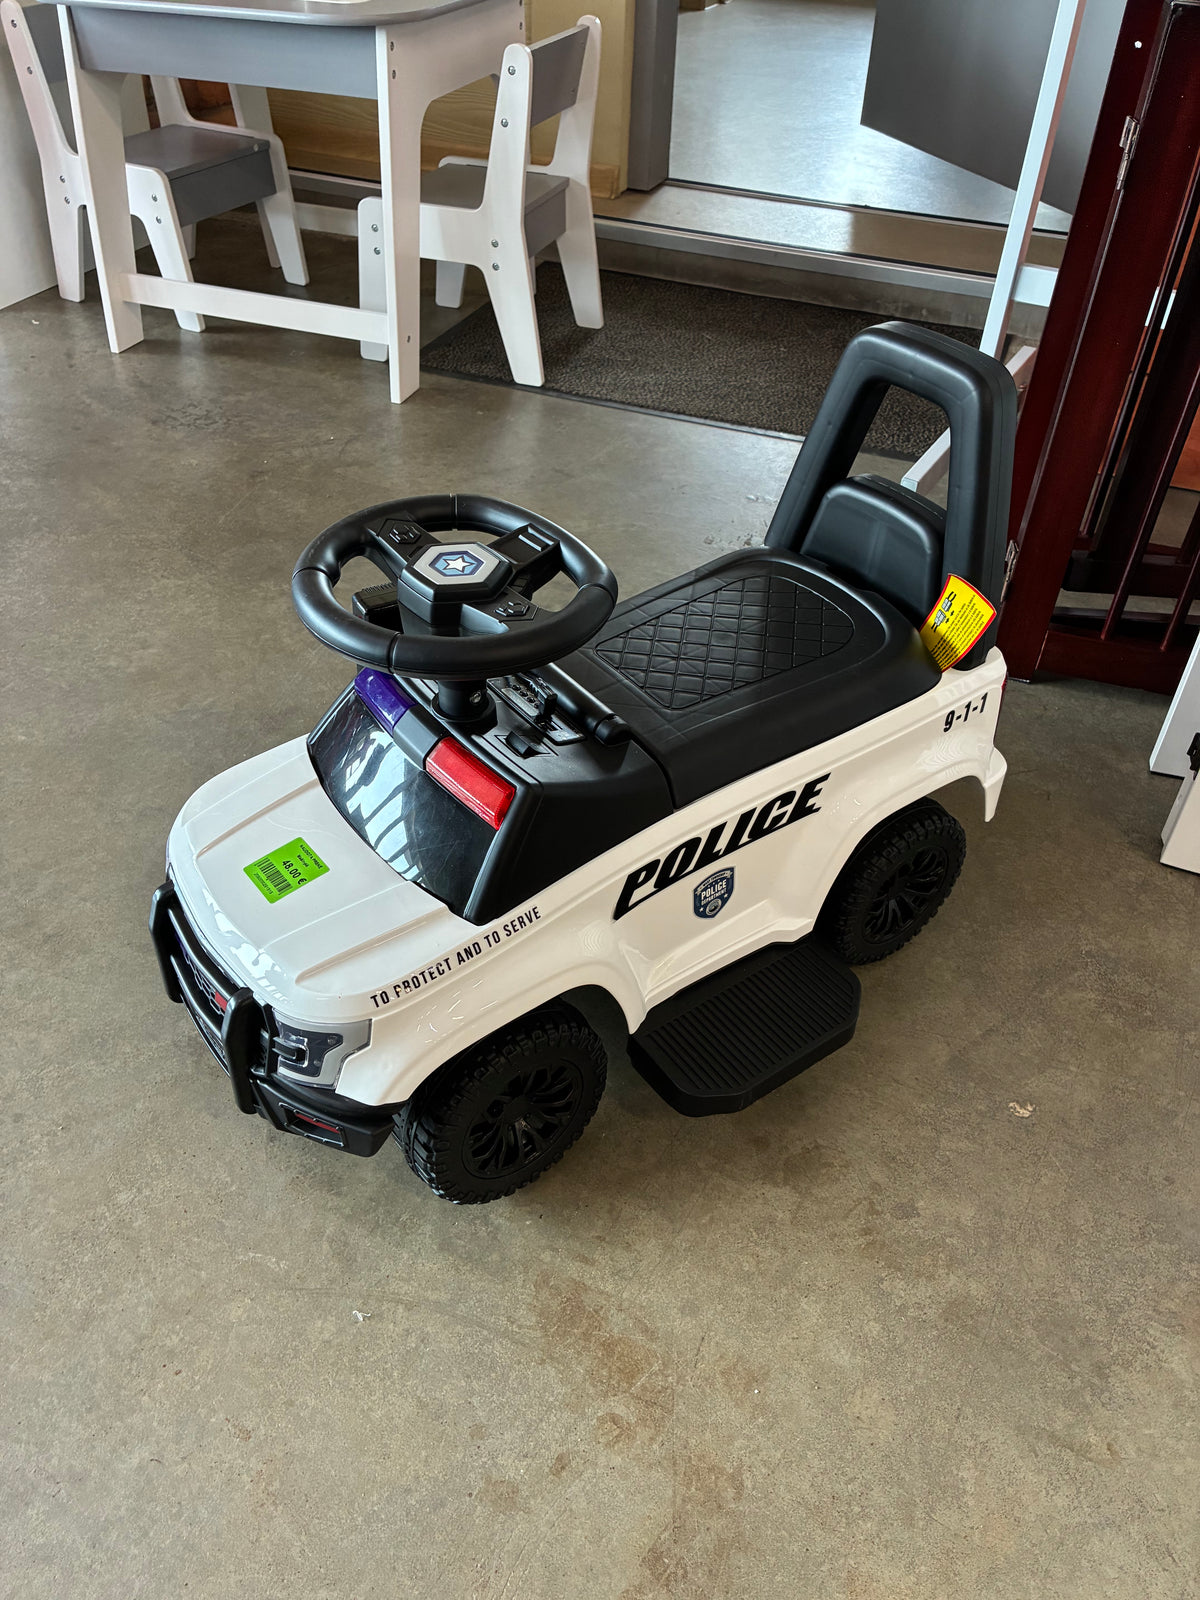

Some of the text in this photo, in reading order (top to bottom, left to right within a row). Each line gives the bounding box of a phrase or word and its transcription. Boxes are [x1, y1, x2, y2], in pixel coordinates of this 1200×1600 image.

[943, 692, 988, 732] 9-1-1
[612, 772, 832, 921] POLICE
[282, 860, 301, 879] 48.00
[701, 879, 727, 900] POLICE
[370, 906, 542, 1008] TO PROTECT AND TO SERVE
